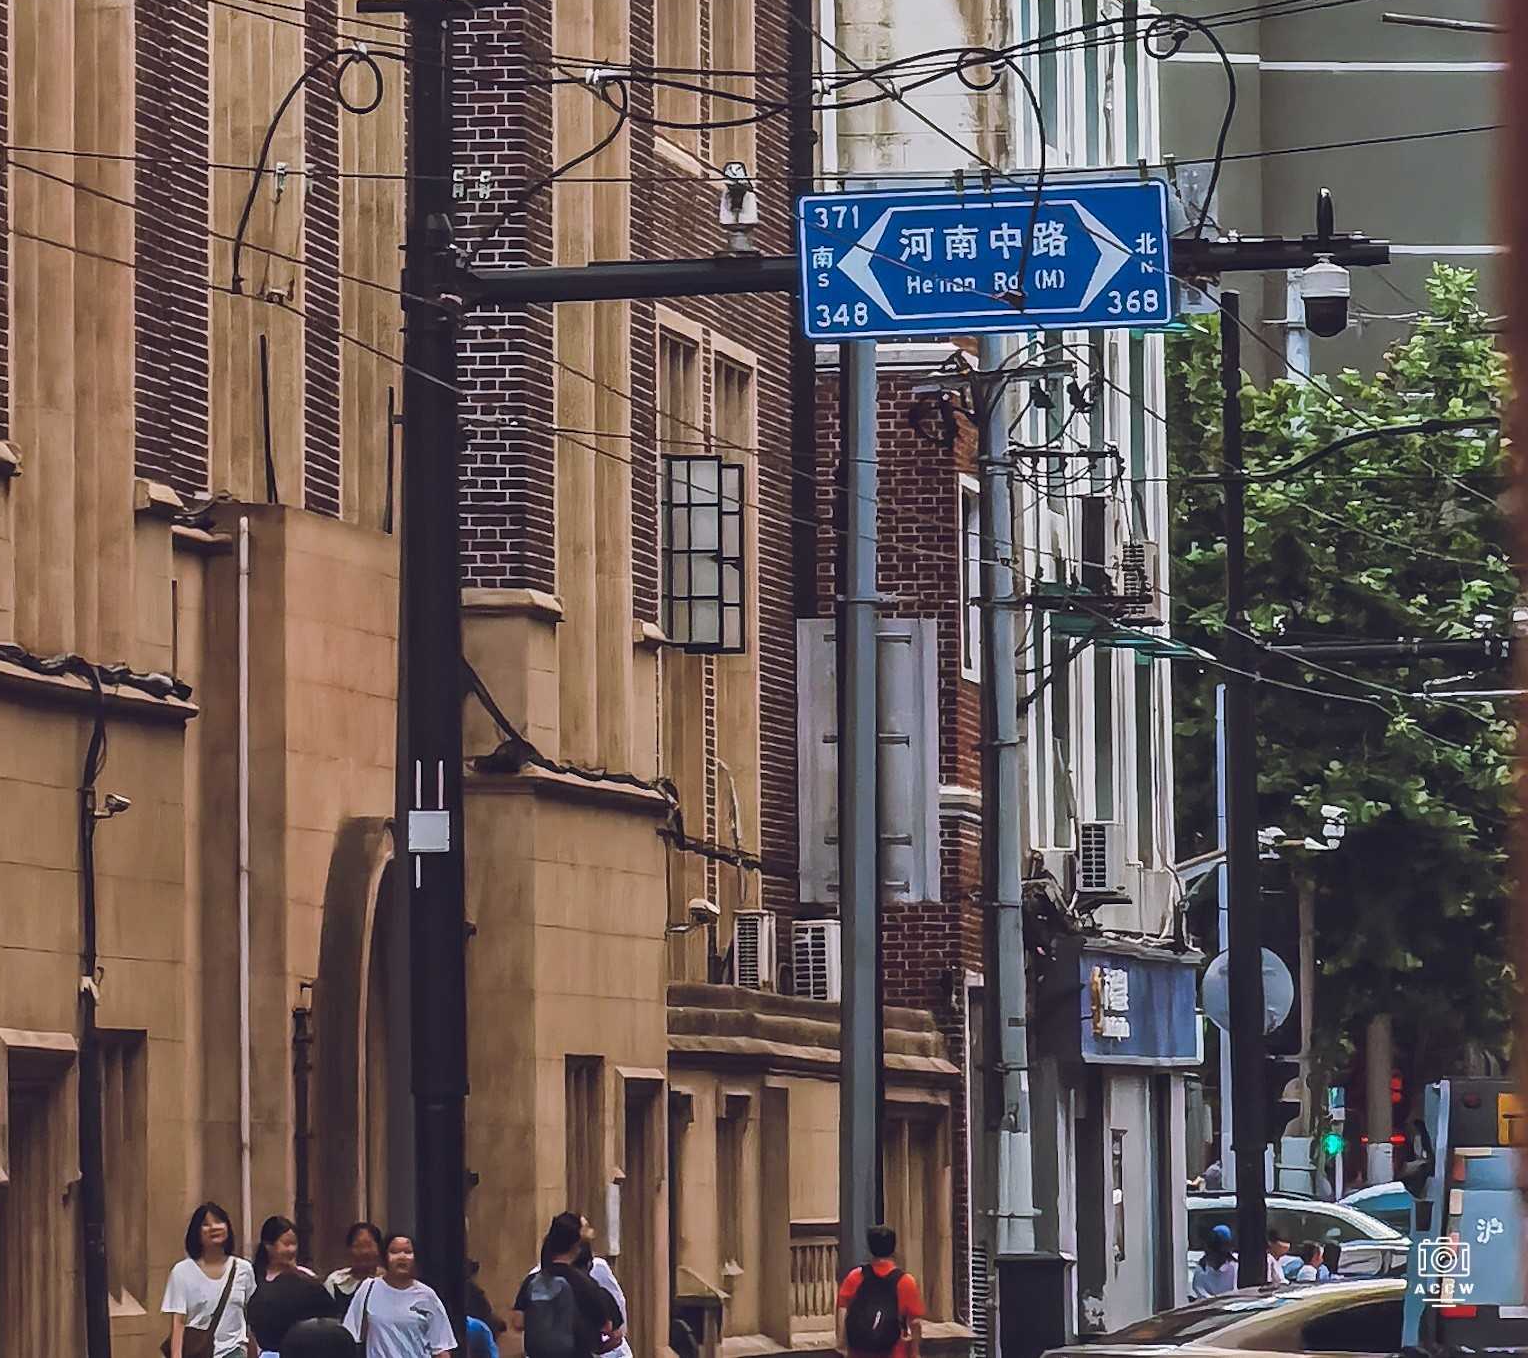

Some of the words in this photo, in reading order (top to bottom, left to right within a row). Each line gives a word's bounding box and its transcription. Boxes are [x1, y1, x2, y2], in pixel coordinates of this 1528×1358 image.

[813, 205, 860, 229] 371
[898, 219, 1069, 263] 河南中路
[1134, 232, 1159, 255] 北
[810, 245, 835, 270] 南
[1140, 259, 1154, 274] N
[817, 272, 831, 288] S
[1034, 268, 1066, 289] (M)
[1106, 289, 1159, 315] 368
[815, 301, 869, 328] 348
